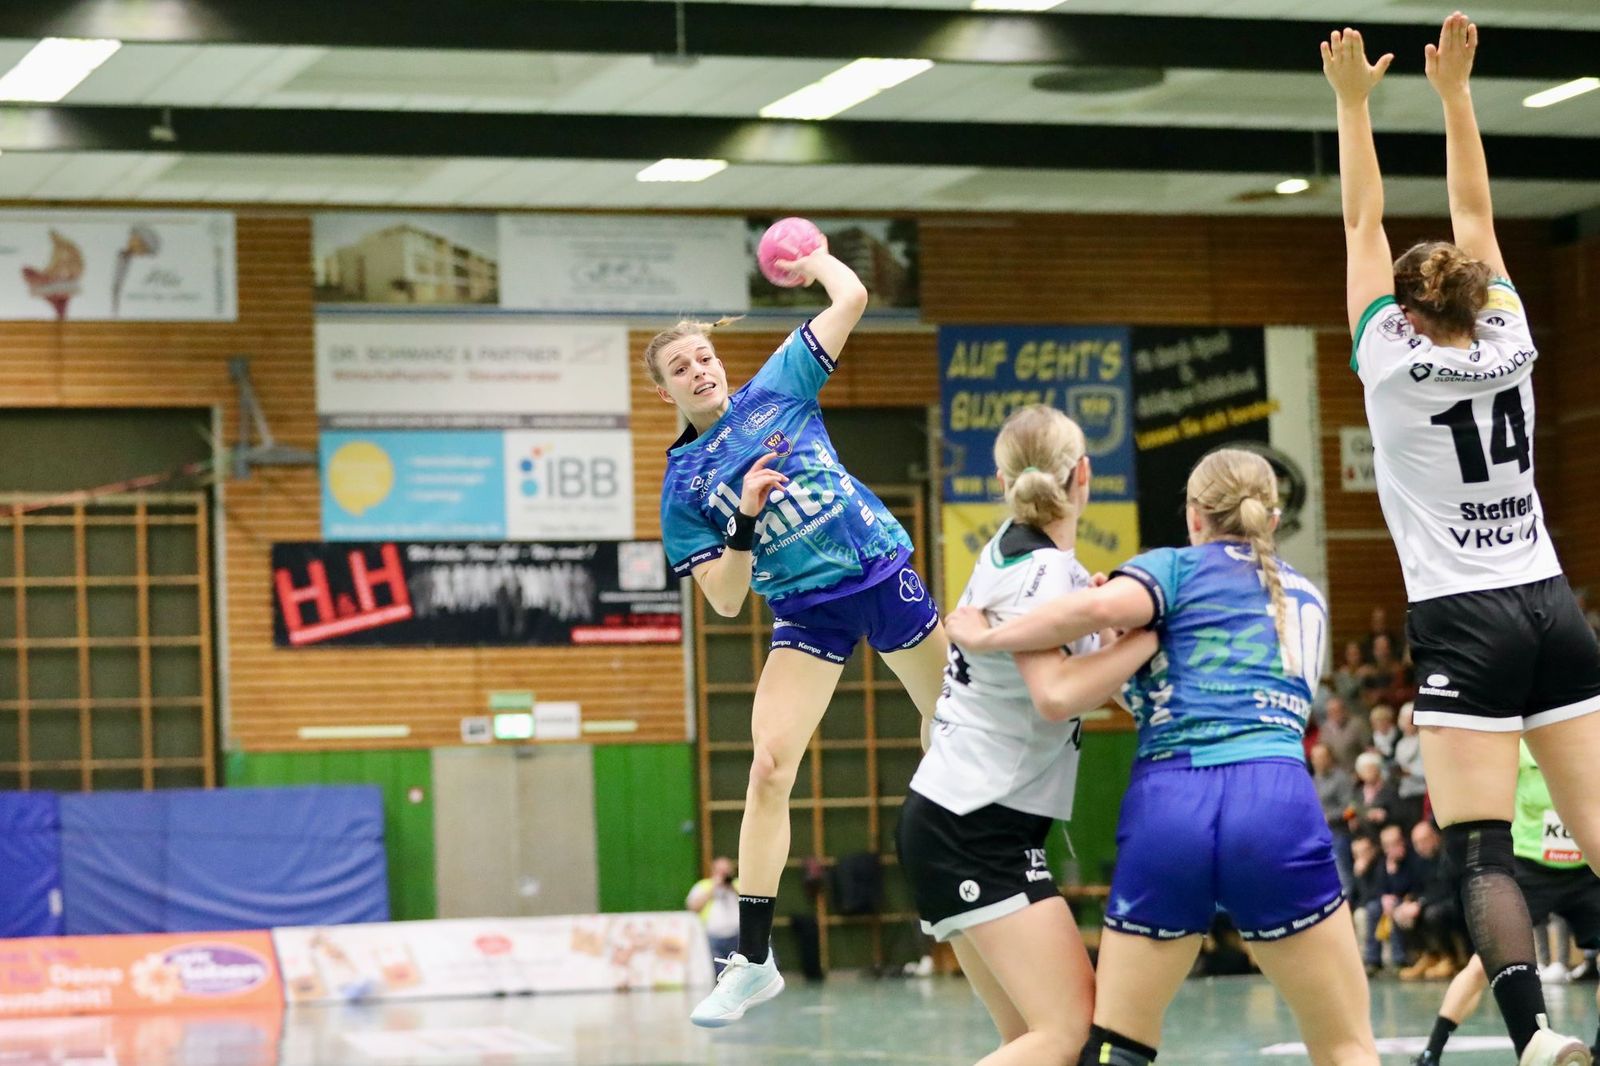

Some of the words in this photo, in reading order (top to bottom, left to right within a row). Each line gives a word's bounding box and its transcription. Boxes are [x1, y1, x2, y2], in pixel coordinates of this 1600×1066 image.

[365, 346, 456, 363] SCHWARZ
[477, 346, 561, 363] PARTNER
[946, 340, 1007, 379] AUF
[1014, 340, 1123, 381] GEHT'S
[705, 426, 733, 453] Kempa
[1430, 385, 1530, 485] 14
[547, 457, 619, 499] IBB
[708, 481, 741, 518] 11
[1460, 493, 1534, 521] Steffen
[764, 503, 845, 556] hit-immobilien.de
[1448, 524, 1515, 549] VRG
[691, 551, 711, 563] Kempa
[771, 639, 791, 648] Kempa
[798, 641, 822, 655] Kempa
[902, 631, 924, 648] Kempa
[1121, 920, 1152, 934] Kempa
[1291, 912, 1320, 929] Kempa
[49, 964, 124, 985] Deine
